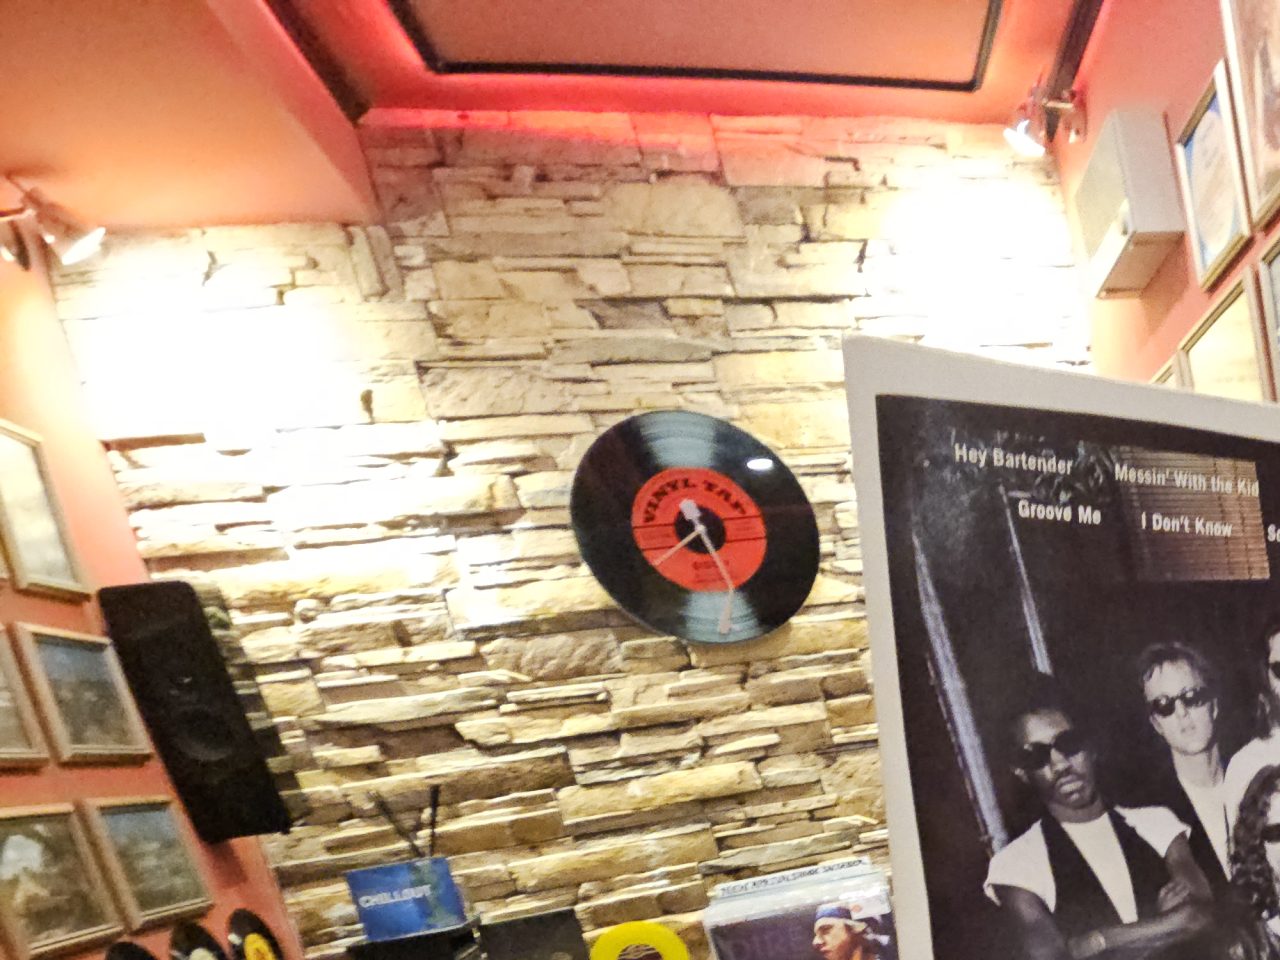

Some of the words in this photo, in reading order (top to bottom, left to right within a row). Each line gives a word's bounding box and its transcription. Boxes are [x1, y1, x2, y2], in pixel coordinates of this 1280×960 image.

[955, 443, 987, 468] Hey
[993, 448, 1072, 475] Bartender
[1115, 463, 1170, 486] Messin'
[1174, 470, 1206, 491] With
[1211, 476, 1233, 494] the
[1237, 478, 1259, 497] Kid
[1018, 499, 1072, 522] Groove
[1078, 505, 1101, 525] Me
[1141, 511, 1147, 529] I
[1152, 513, 1190, 533] Don't
[1195, 517, 1233, 537] Know
